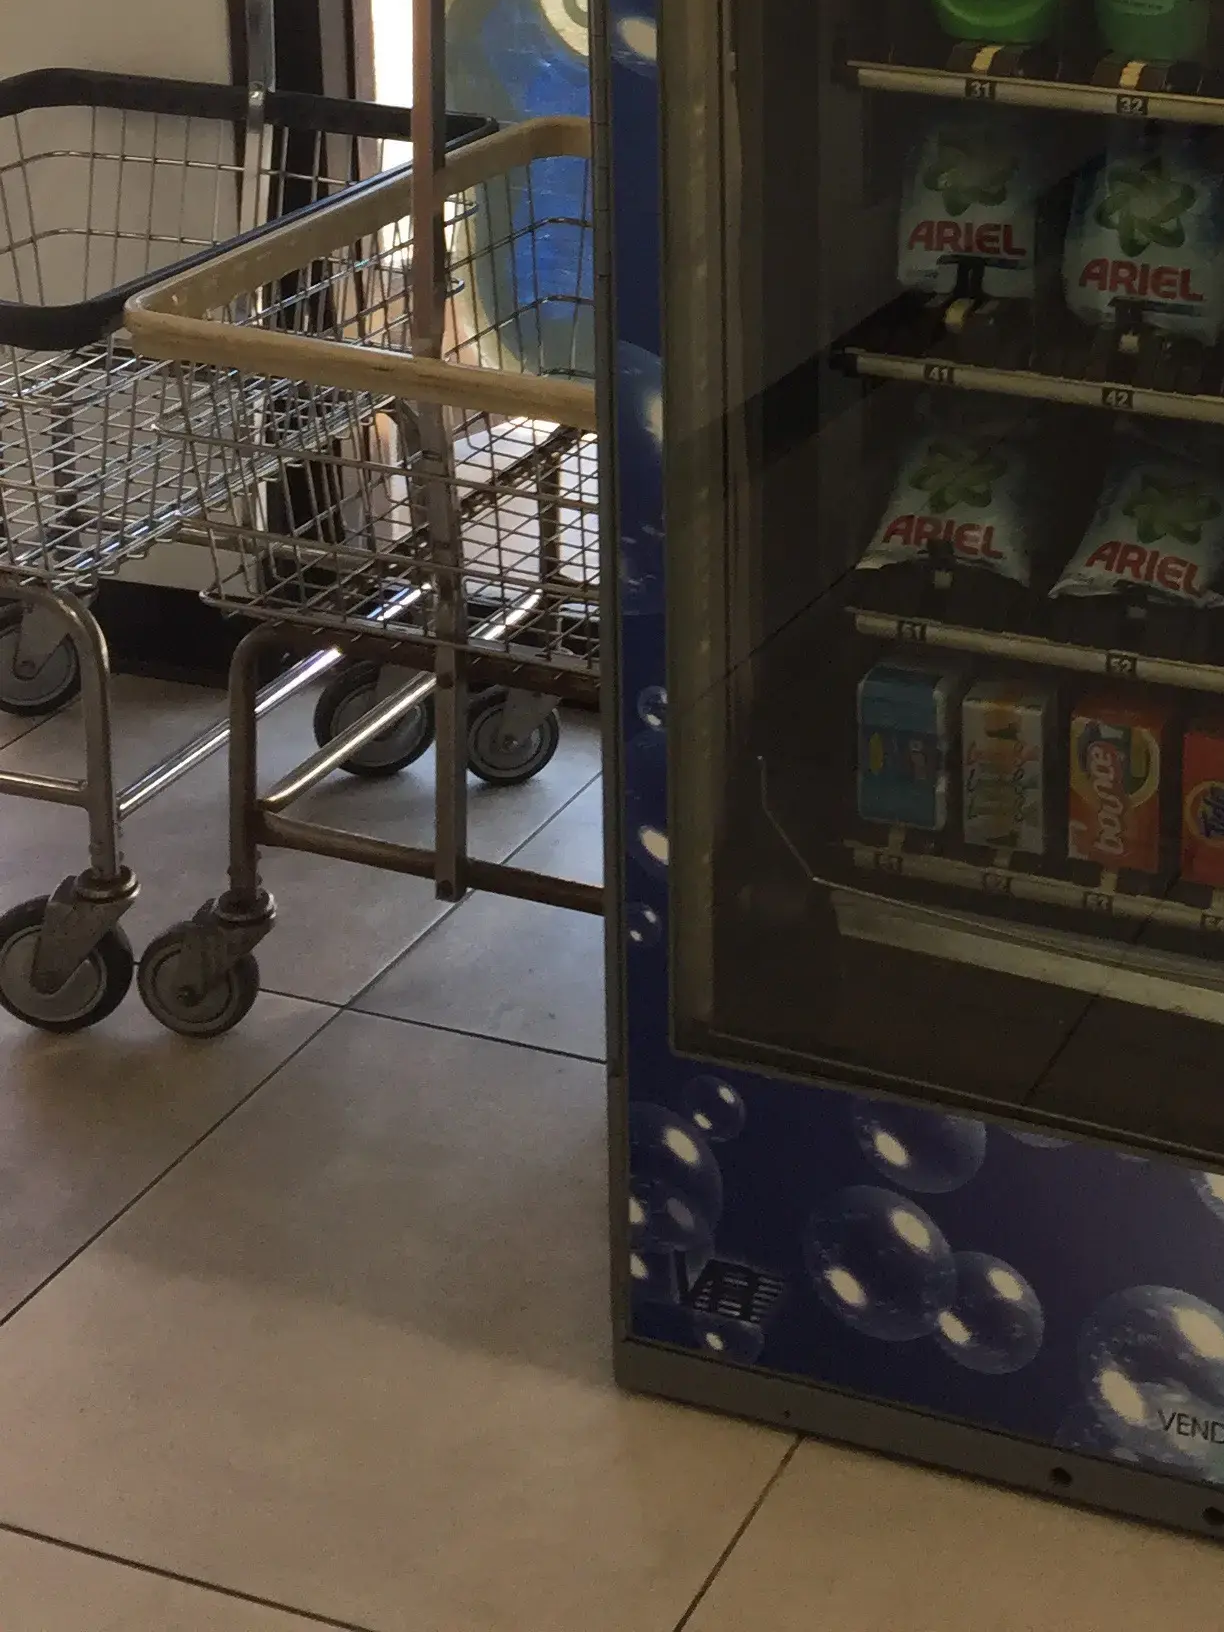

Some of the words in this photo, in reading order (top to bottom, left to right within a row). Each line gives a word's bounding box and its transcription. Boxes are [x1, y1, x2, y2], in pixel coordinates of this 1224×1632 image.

[970, 80, 991, 98] 31
[1120, 96, 1144, 115] 32
[907, 219, 1027, 257] ARIEL
[1078, 257, 1205, 303] ARIEL
[927, 366, 949, 382] 41
[1105, 389, 1129, 408] 42
[881, 514, 1003, 560] ARIEL
[1084, 540, 1206, 599] ARIEL
